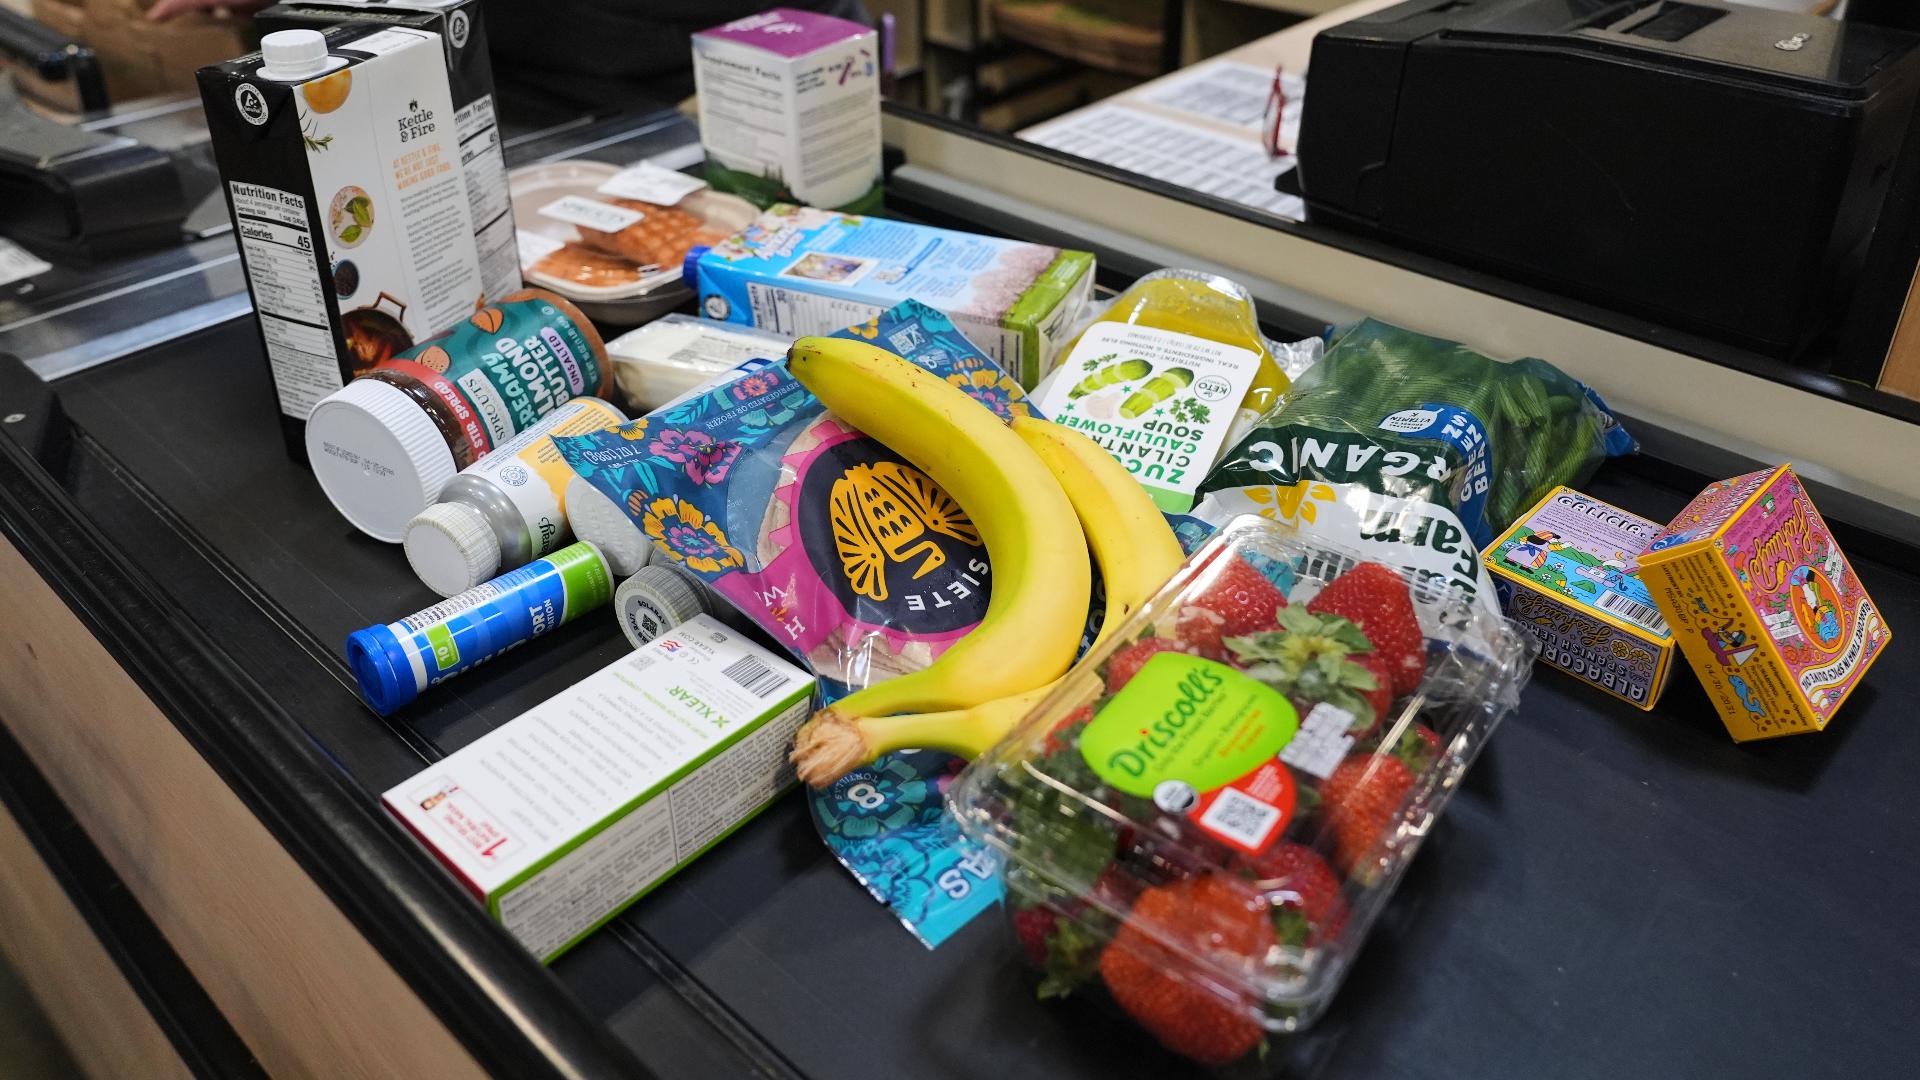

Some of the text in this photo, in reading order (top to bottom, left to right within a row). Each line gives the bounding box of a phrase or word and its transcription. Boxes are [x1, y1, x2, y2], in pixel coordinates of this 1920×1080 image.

[398, 108, 434, 131] Kettle
[400, 121, 436, 143] & Fire
[232, 183, 304, 209] Nutrition Facts
[240, 226, 311, 249] Calories 45
[548, 335, 582, 386] UNSALTED
[1162, 347, 1216, 364] INGREDIENTS
[1216, 359, 1240, 370] REAL
[495, 337, 549, 420] LMOND
[524, 334, 570, 410] BUTTER
[1197, 380, 1228, 395] KETO
[432, 380, 484, 451] STIR SPREAD
[468, 378, 507, 442] SPROUTS
[705, 381, 800, 430] REFRIGERATED OR FROZEN
[1390, 415, 1431, 424] VITAMIN
[1055, 413, 1198, 454] CAULIFLOWER
[1142, 418, 1204, 441] SOUP
[584, 447, 620, 466] (198g)
[617, 445, 632, 458] OZ
[1091, 435, 1191, 468] CILANTR
[1249, 437, 1452, 484] RGANIC
[1360, 510, 1479, 585] Farm
[1748, 497, 1813, 594] Fishwife
[904, 558, 989, 612] SIETE
[530, 605, 543, 638] ORT
[637, 600, 666, 625] SOLARAY
[1847, 599, 1878, 644] ALBACORE
[438, 646, 448, 662] 10
[1560, 636, 1627, 678] SPANISH
[1844, 638, 1862, 664] TUNA
[1807, 661, 1828, 692] OLIVE
[1825, 656, 1845, 686] SPICY
[661, 684, 722, 719] XLEAR
[1107, 666, 1224, 779] Driscoll's
[847, 783, 885, 810] 8
